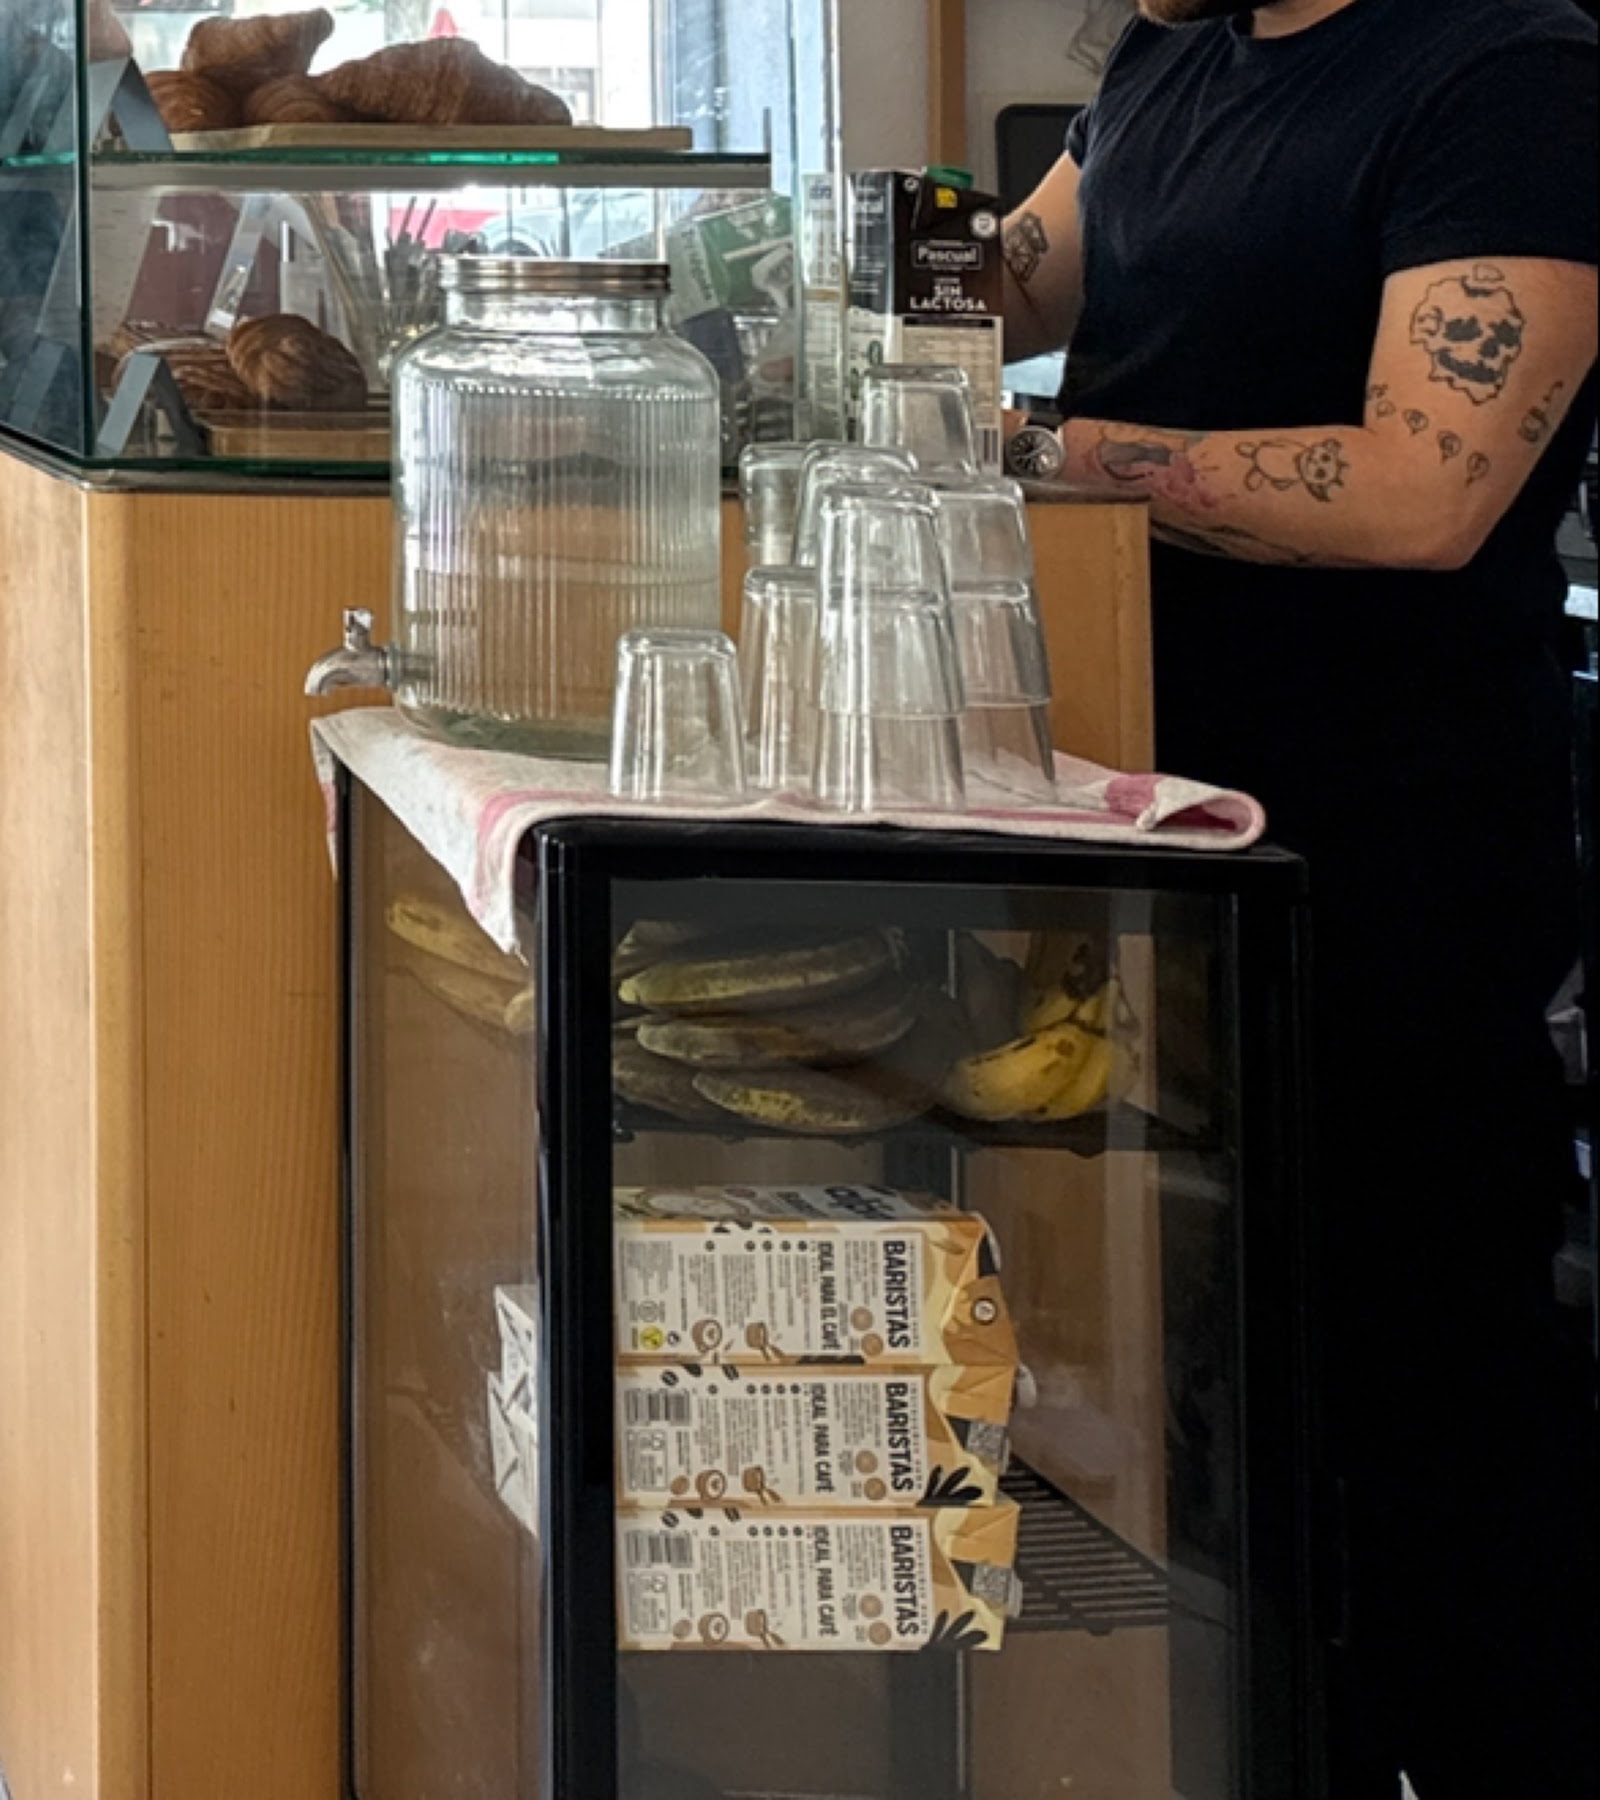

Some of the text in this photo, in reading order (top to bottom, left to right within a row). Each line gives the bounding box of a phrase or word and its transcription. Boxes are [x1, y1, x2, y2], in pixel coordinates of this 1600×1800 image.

[918, 245, 977, 262] Pascual
[909, 296, 987, 311] LACTOSA
[933, 285, 962, 296] SIN
[820, 1276, 836, 1304] PARA
[883, 1240, 911, 1348] BARISTAS
[823, 1322, 841, 1350] CAFÉ
[814, 1423, 829, 1457] PARA
[885, 1382, 914, 1491] BARISTAS
[815, 1461, 835, 1492] CAFÉ
[817, 1568, 834, 1600] PARA
[890, 1526, 919, 1635] BARISTAS
[817, 1603, 839, 1637] CAFÉ
